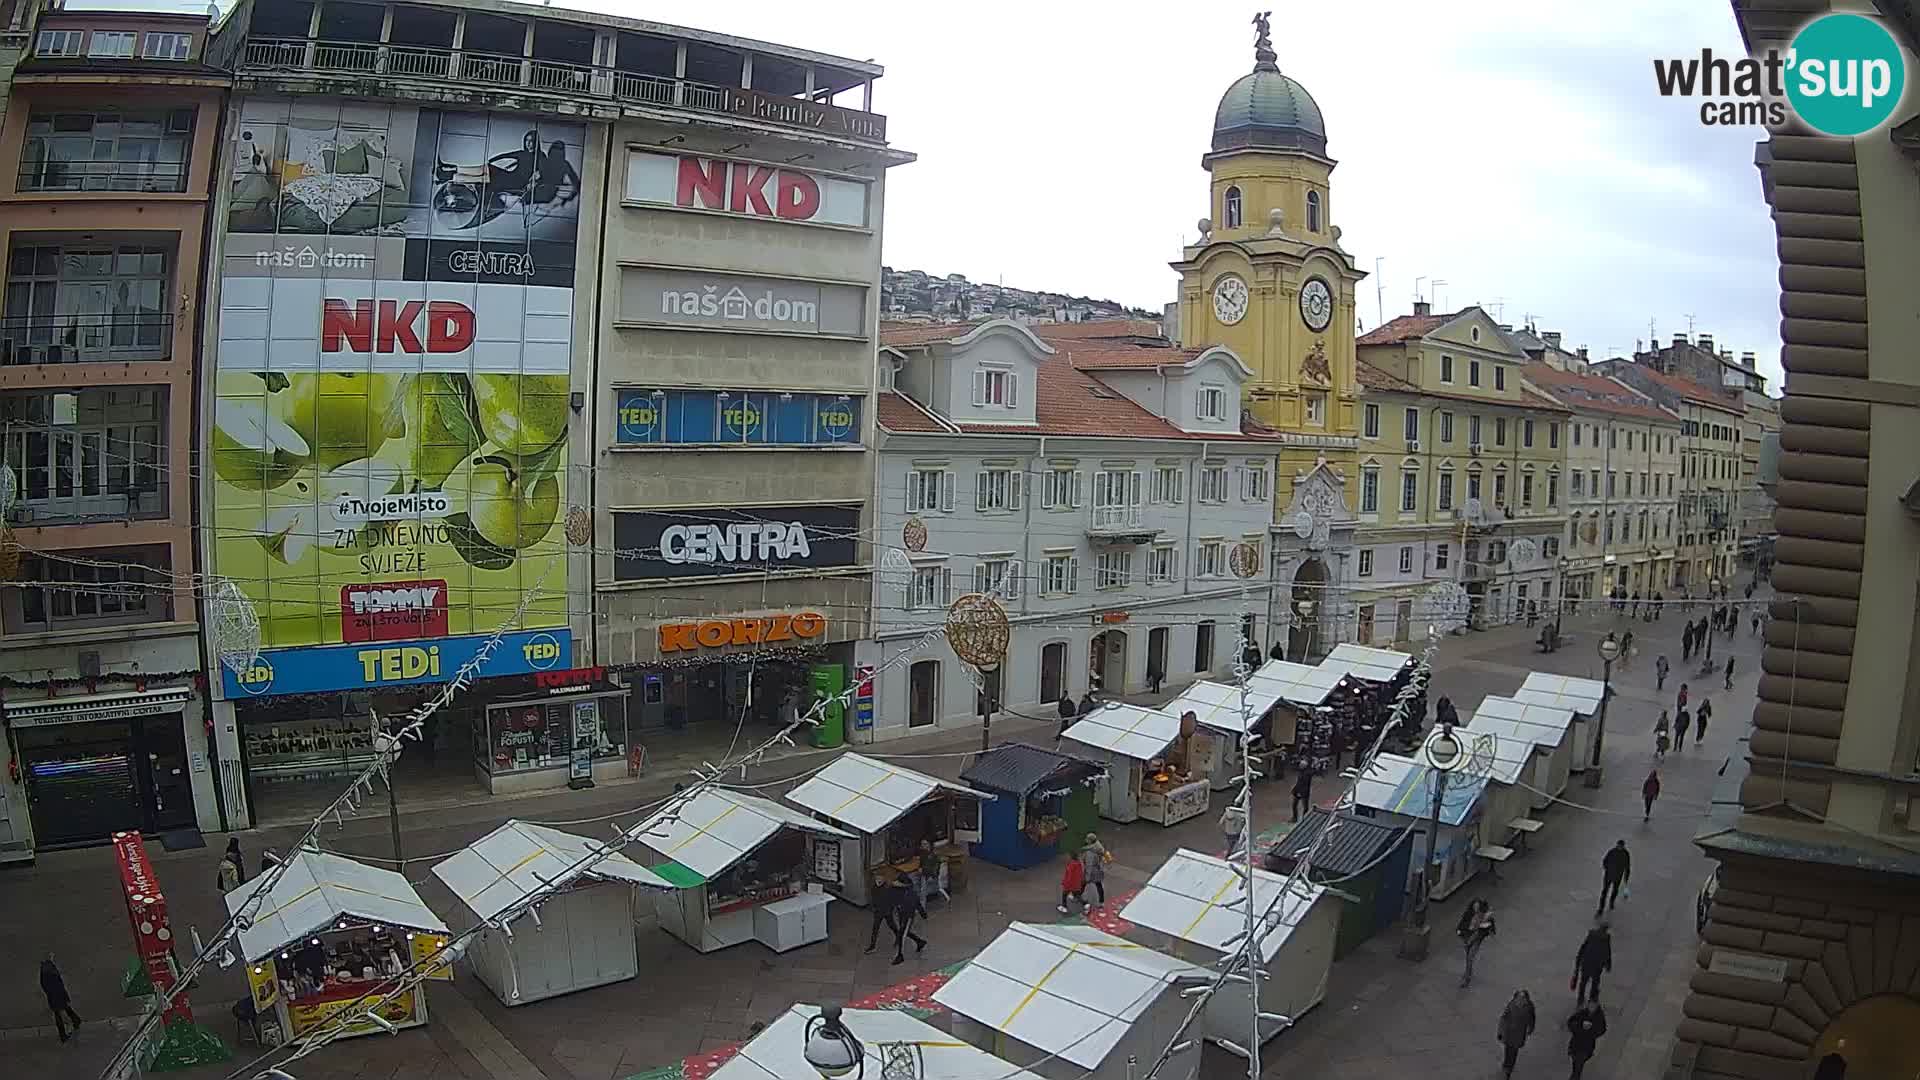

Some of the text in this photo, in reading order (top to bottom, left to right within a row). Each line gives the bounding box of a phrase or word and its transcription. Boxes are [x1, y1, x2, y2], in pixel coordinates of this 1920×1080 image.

[675, 157, 822, 221] NKD
[254, 246, 366, 269] naš dom
[448, 250, 536, 277] CENTRA
[661, 284, 817, 323] naš dom
[321, 297, 477, 354] NKD
[338, 497, 446, 516] #TvojeMisto
[334, 524, 450, 549] ZA DNEVNO
[659, 521, 811, 564] CENTRA
[360, 547, 427, 575] SVJEŽE
[349, 586, 440, 614] TOMMY
[658, 611, 826, 652] KORZO
[358, 646, 440, 682] TEDi
[522, 642, 560, 660] TEDi
